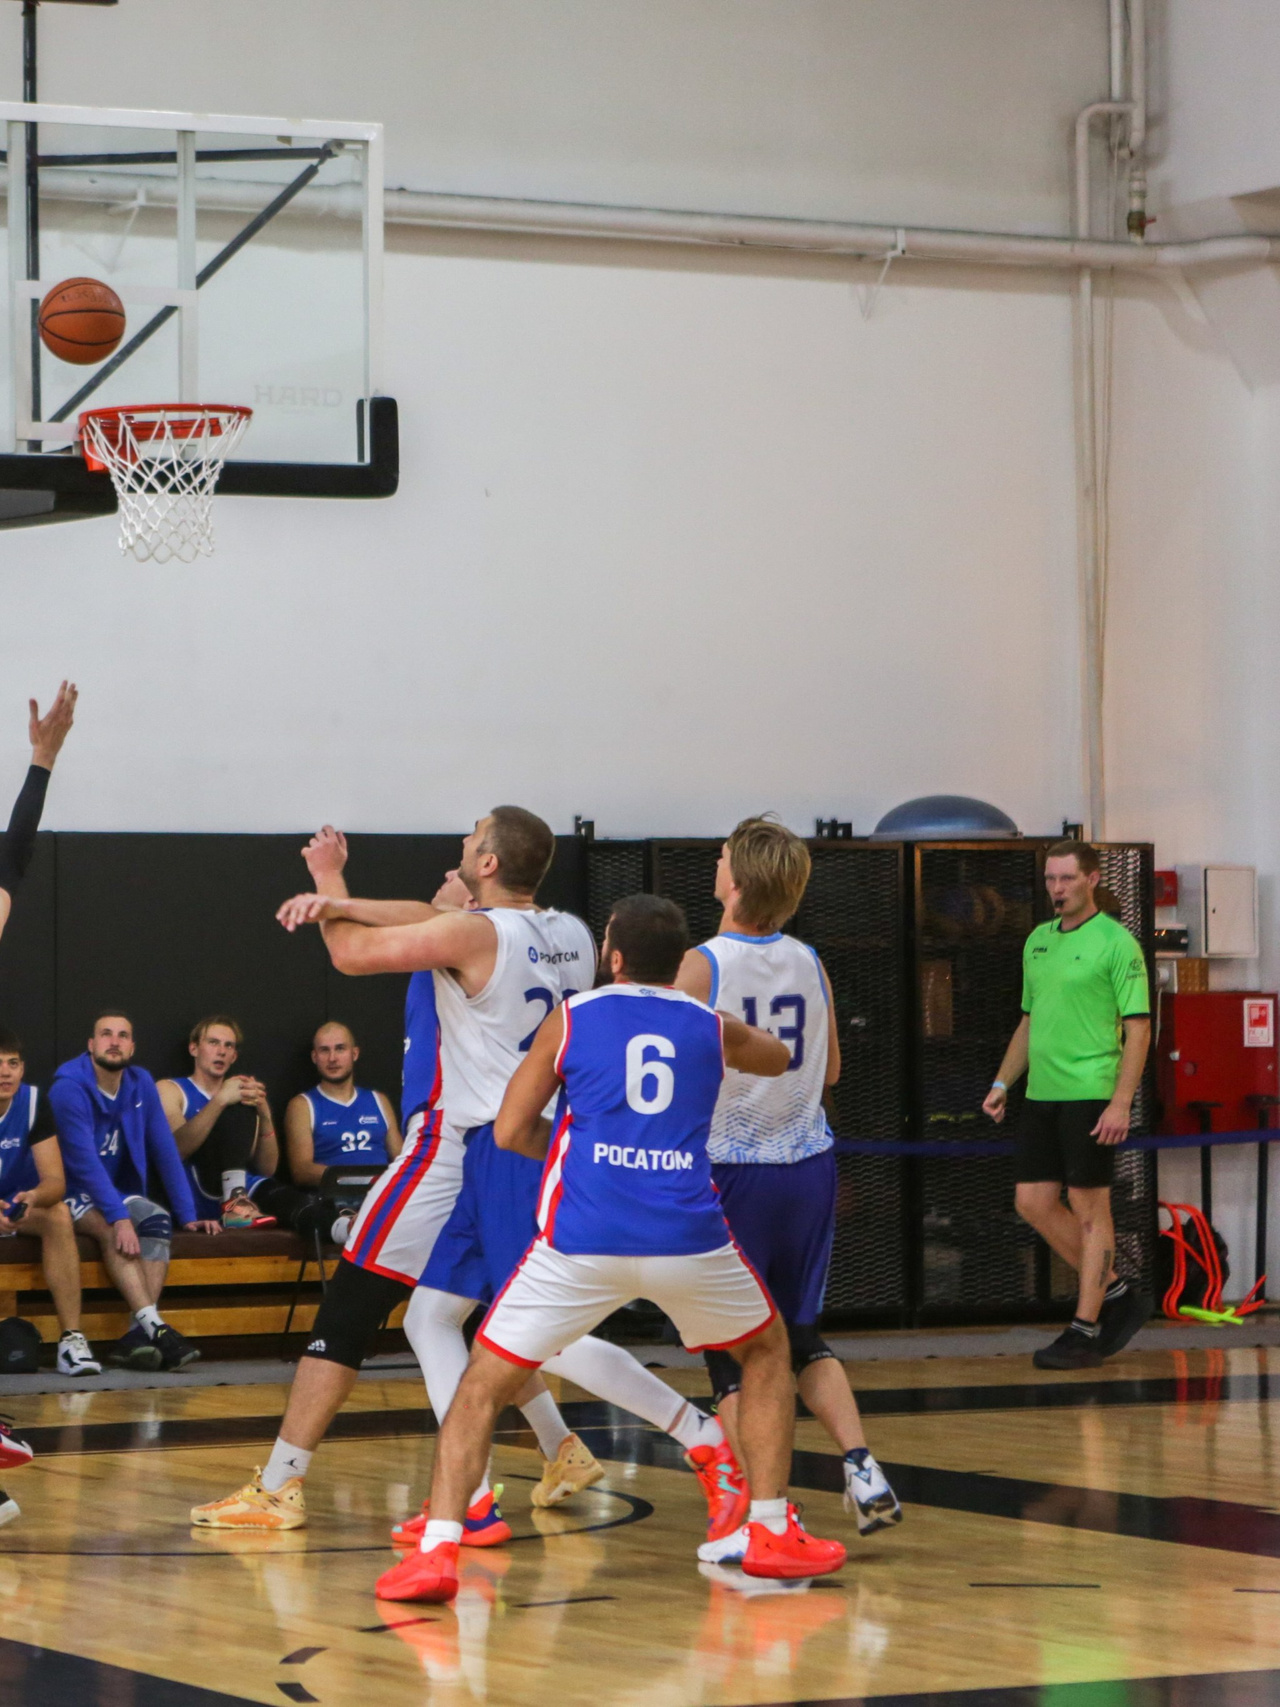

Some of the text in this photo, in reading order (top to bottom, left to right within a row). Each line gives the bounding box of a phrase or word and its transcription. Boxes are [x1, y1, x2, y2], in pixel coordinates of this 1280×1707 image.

[254, 384, 343, 408] HARD
[518, 986, 580, 1052] 2
[625, 1033, 676, 1115] 6
[341, 1130, 372, 1153] 32
[593, 1142, 694, 1171] РОСАТОМ
